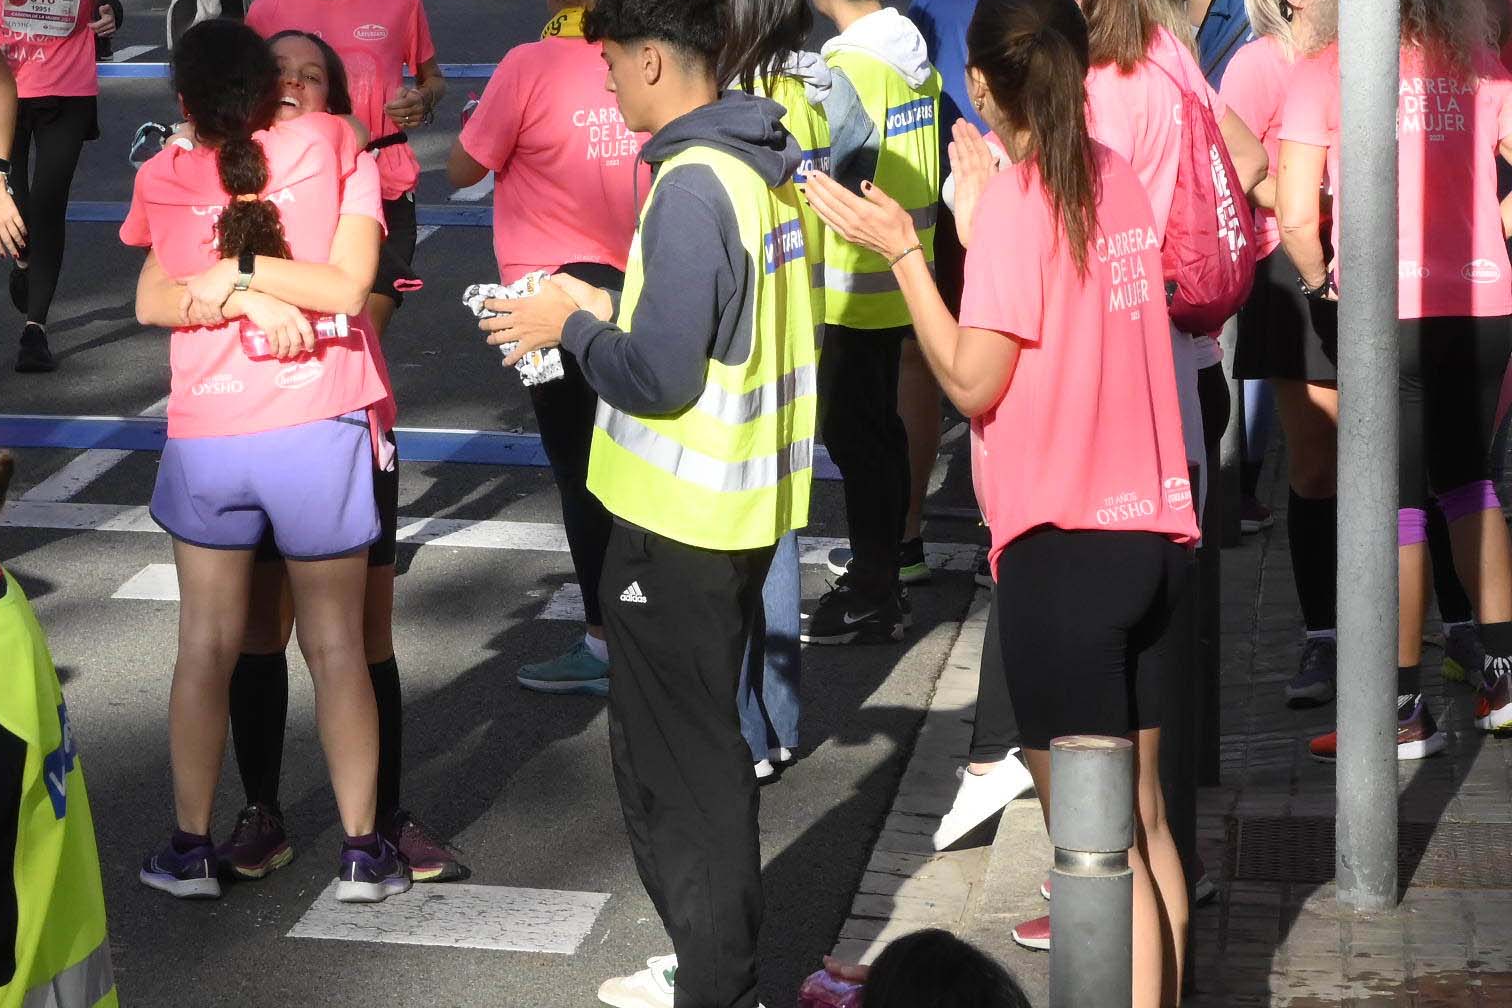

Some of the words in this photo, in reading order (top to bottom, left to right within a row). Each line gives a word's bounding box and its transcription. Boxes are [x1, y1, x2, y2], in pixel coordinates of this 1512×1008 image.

[1399, 77, 1475, 96] ARRERA
[1404, 95, 1429, 114] DE
[1437, 95, 1460, 112] LA
[1402, 114, 1465, 133] MUJER
[590, 125, 610, 142] DE
[586, 140, 639, 160] MUJER
[1096, 226, 1158, 263] CARRERA
[1111, 261, 1128, 284] DE
[1130, 255, 1145, 278] LA
[1108, 279, 1149, 312] MUJER
[1096, 499, 1154, 525] OYSHO
[619, 592, 647, 604] adidas
